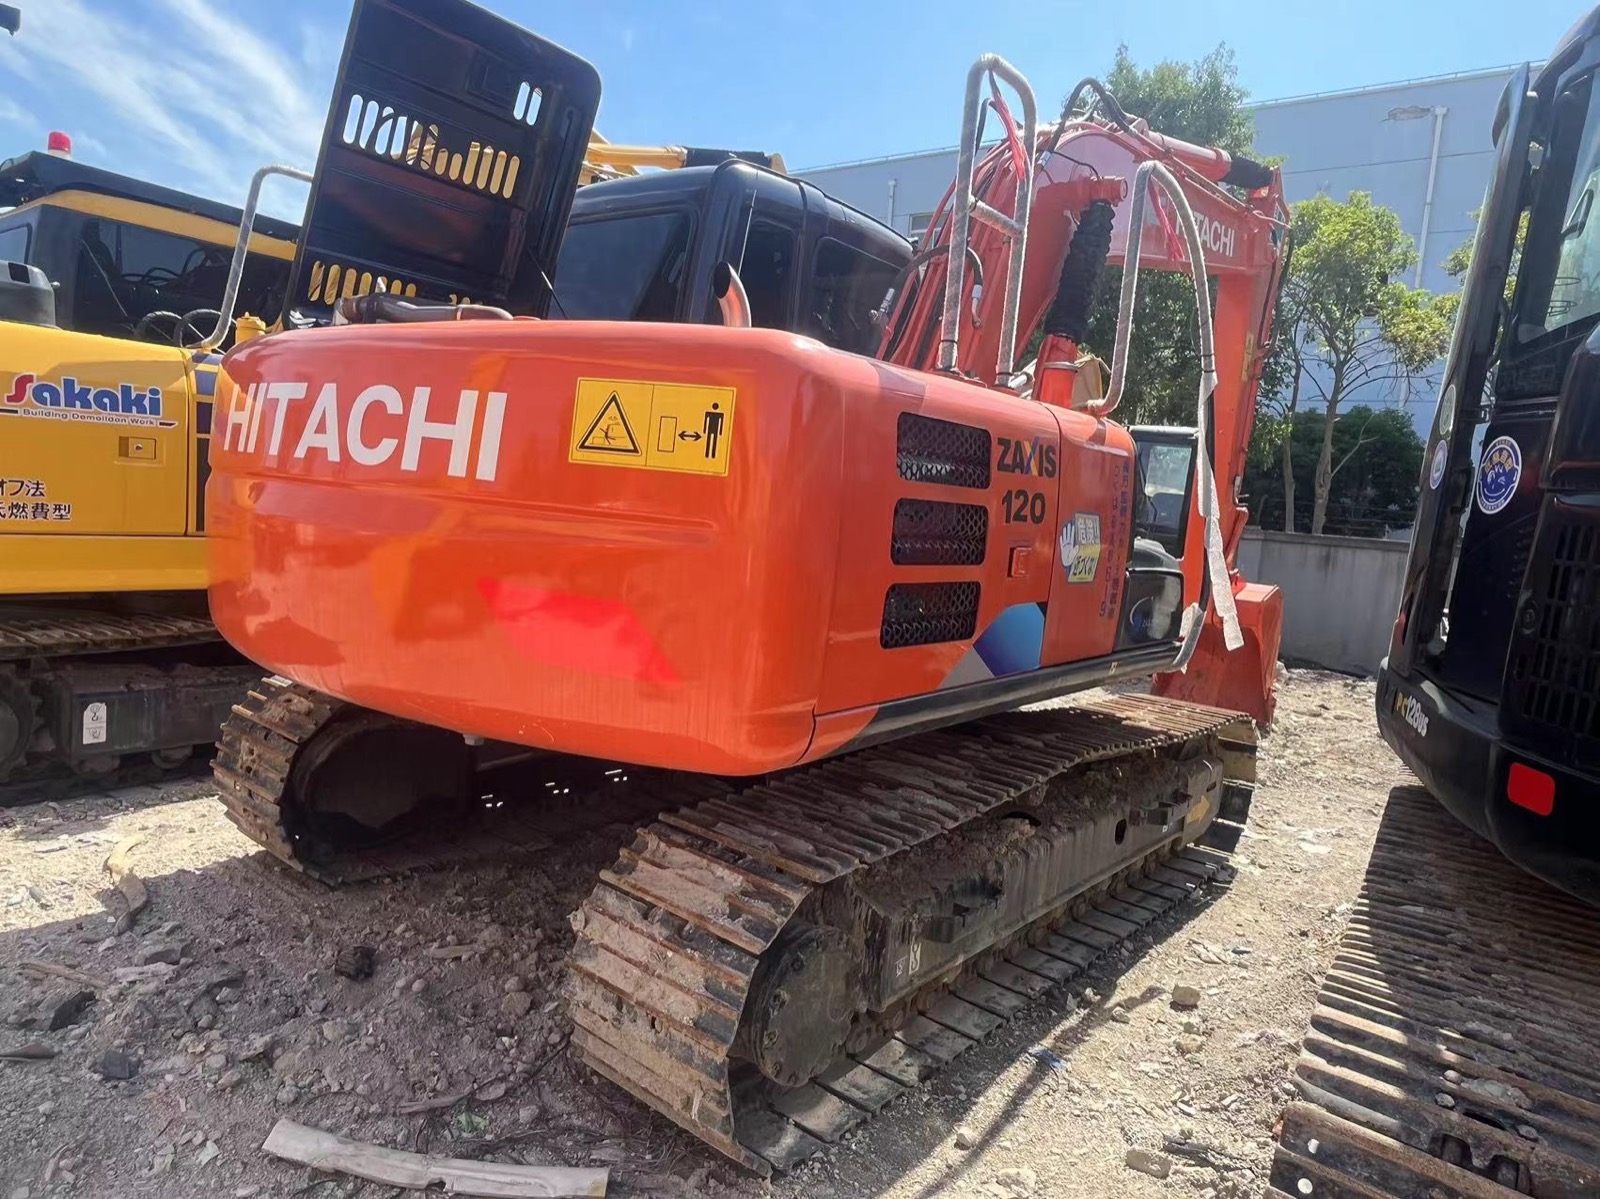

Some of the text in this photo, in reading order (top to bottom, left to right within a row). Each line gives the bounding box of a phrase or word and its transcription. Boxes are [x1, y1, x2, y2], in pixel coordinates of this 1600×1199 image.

[1176, 211, 1235, 257] TACHI
[6, 374, 161, 416] Sakaki
[23, 408, 69, 420] Building
[129, 417, 155, 427] Work
[223, 382, 508, 481] HITACHI
[997, 436, 1057, 478] ZAXIS
[1002, 489, 1046, 524] 120
